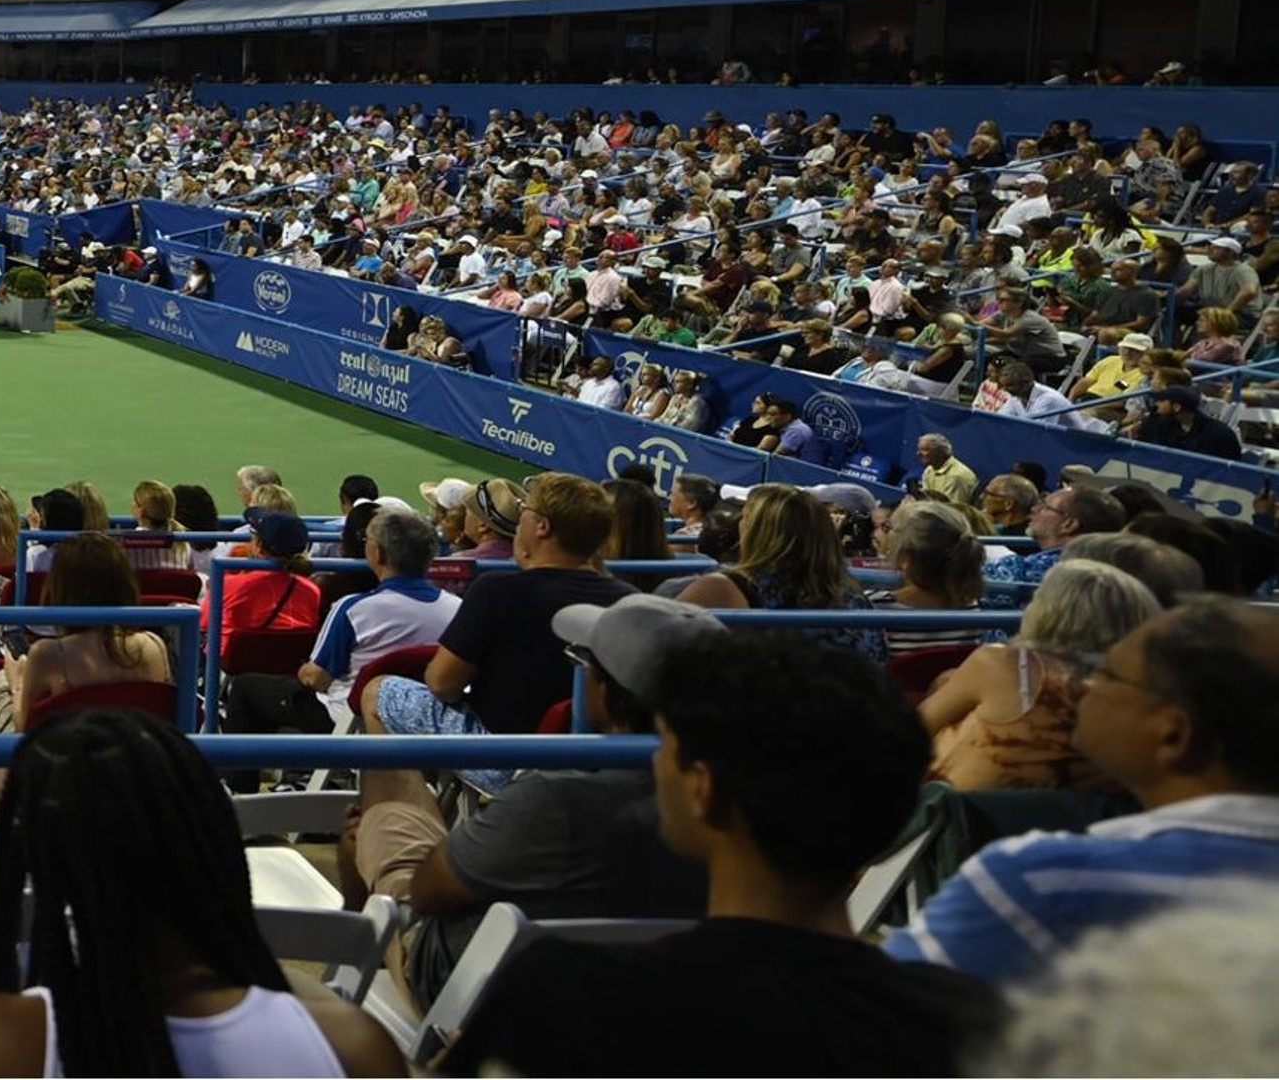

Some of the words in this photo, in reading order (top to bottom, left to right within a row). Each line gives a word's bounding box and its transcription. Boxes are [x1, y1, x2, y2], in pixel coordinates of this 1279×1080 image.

[254, 336, 290, 356] MODERN
[340, 350, 366, 371] real
[337, 373, 372, 398] DREAM
[375, 386, 408, 414] SEATS
[481, 418, 556, 457] Tecnifibre
